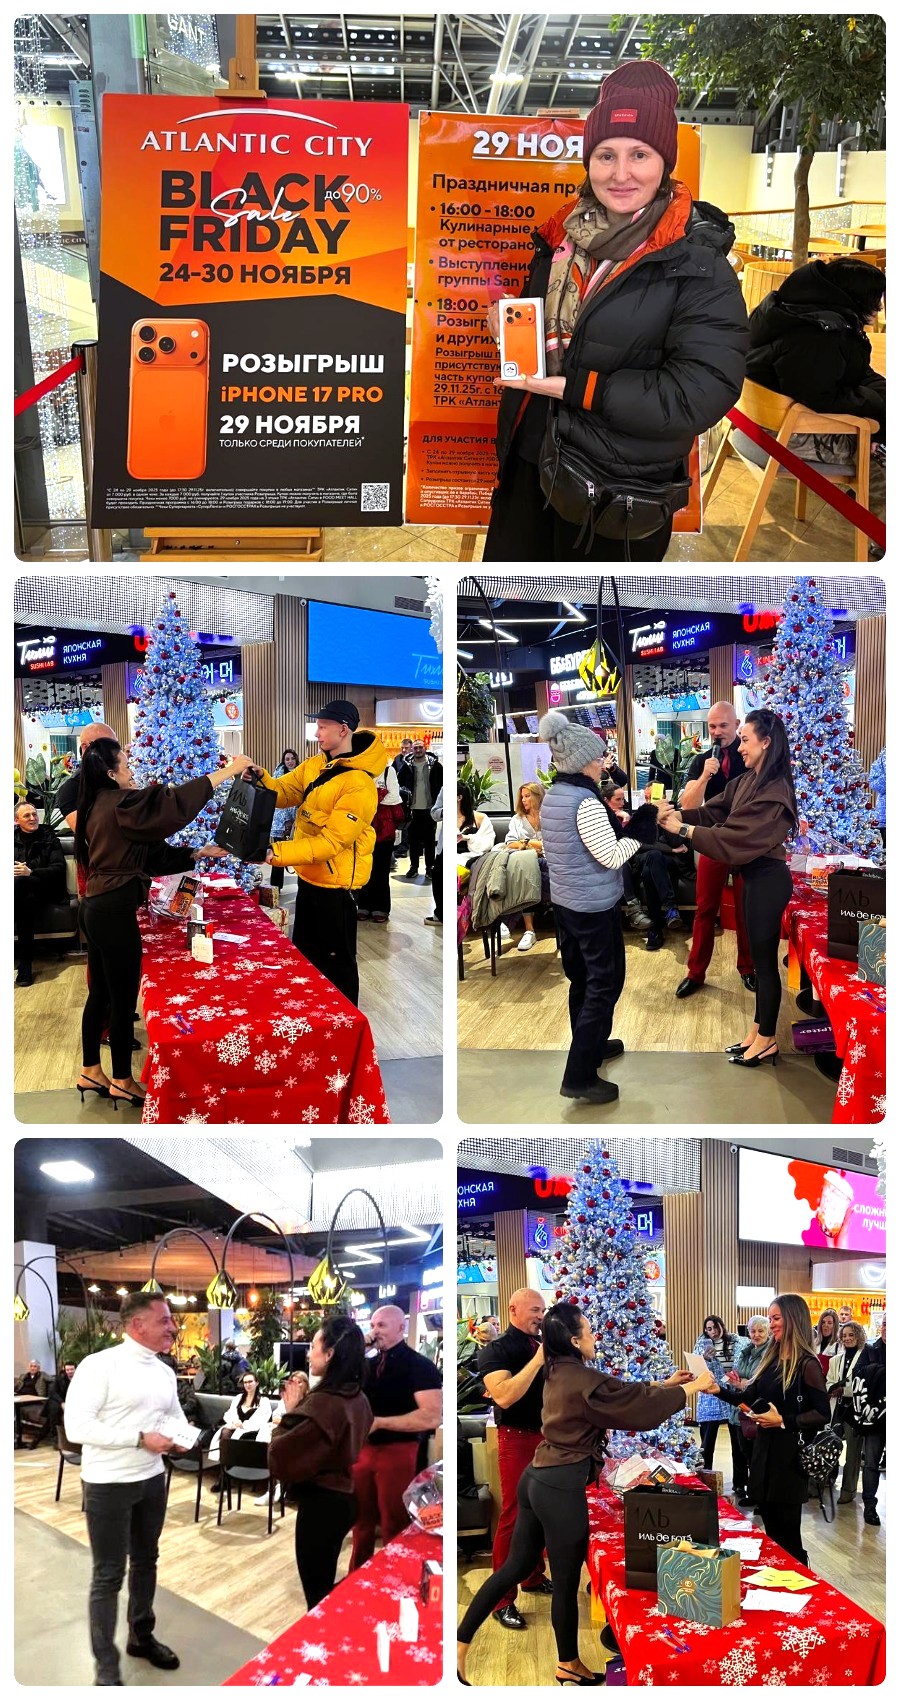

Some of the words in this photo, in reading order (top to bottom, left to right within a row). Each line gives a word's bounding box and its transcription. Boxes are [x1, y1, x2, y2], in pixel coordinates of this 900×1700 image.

[141, 131, 290, 155] ATLANTIC
[304, 135, 373, 157] CITY
[472, 130, 510, 155] 29
[517, 133, 583, 158] НОЯ
[160, 170, 351, 213] BLACK
[432, 173, 550, 195] Праздничная
[324, 190, 341, 201] до
[342, 183, 382, 204] 90%
[210, 186, 300, 228] Sale
[440, 203, 481, 216] 16:00
[494, 205, 535, 218] 18:00
[159, 214, 351, 254] FRIDAY
[440, 219, 531, 236] Кулинарные
[439, 239, 455, 248] от
[458, 238, 534, 252] ресторано
[159, 262, 234, 283] 24-30
[240, 264, 351, 285] НОЯБРЯ
[438, 275, 490, 289] группы
[493, 275, 520, 287] San
[436, 299, 478, 312] 18:00
[436, 334, 444, 343] и
[447, 334, 499, 347] других
[436, 348, 492, 358] Розыгрыш
[222, 353, 385, 373] РОЗЫГРЫШ
[434, 374, 464, 382] часть
[220, 385, 308, 403] iPHONE
[312, 386, 333, 403] 17
[337, 386, 384, 403] PRO
[434, 384, 483, 394] 29.11.25г.
[434, 396, 456, 406] ТРК
[219, 414, 250, 434] 29
[255, 414, 360, 434] НОЯБРЯ
[219, 439, 257, 448] ТОЛЬКО
[259, 439, 292, 448] СРЕДИ
[422, 436, 442, 444] ДЛЯ
[445, 436, 488, 444] УЧАСТИЯ
[672, 622, 710, 638] ЯПОНСКАЯ
[63, 639, 102, 654] ЯПОНСКАЯ
[672, 638, 695, 650] КУХНЯ
[64, 654, 86, 664] КУХНЯ
[458, 1182, 494, 1196] ОНСКАЯ
[458, 1198, 476, 1208] ХНЯ
